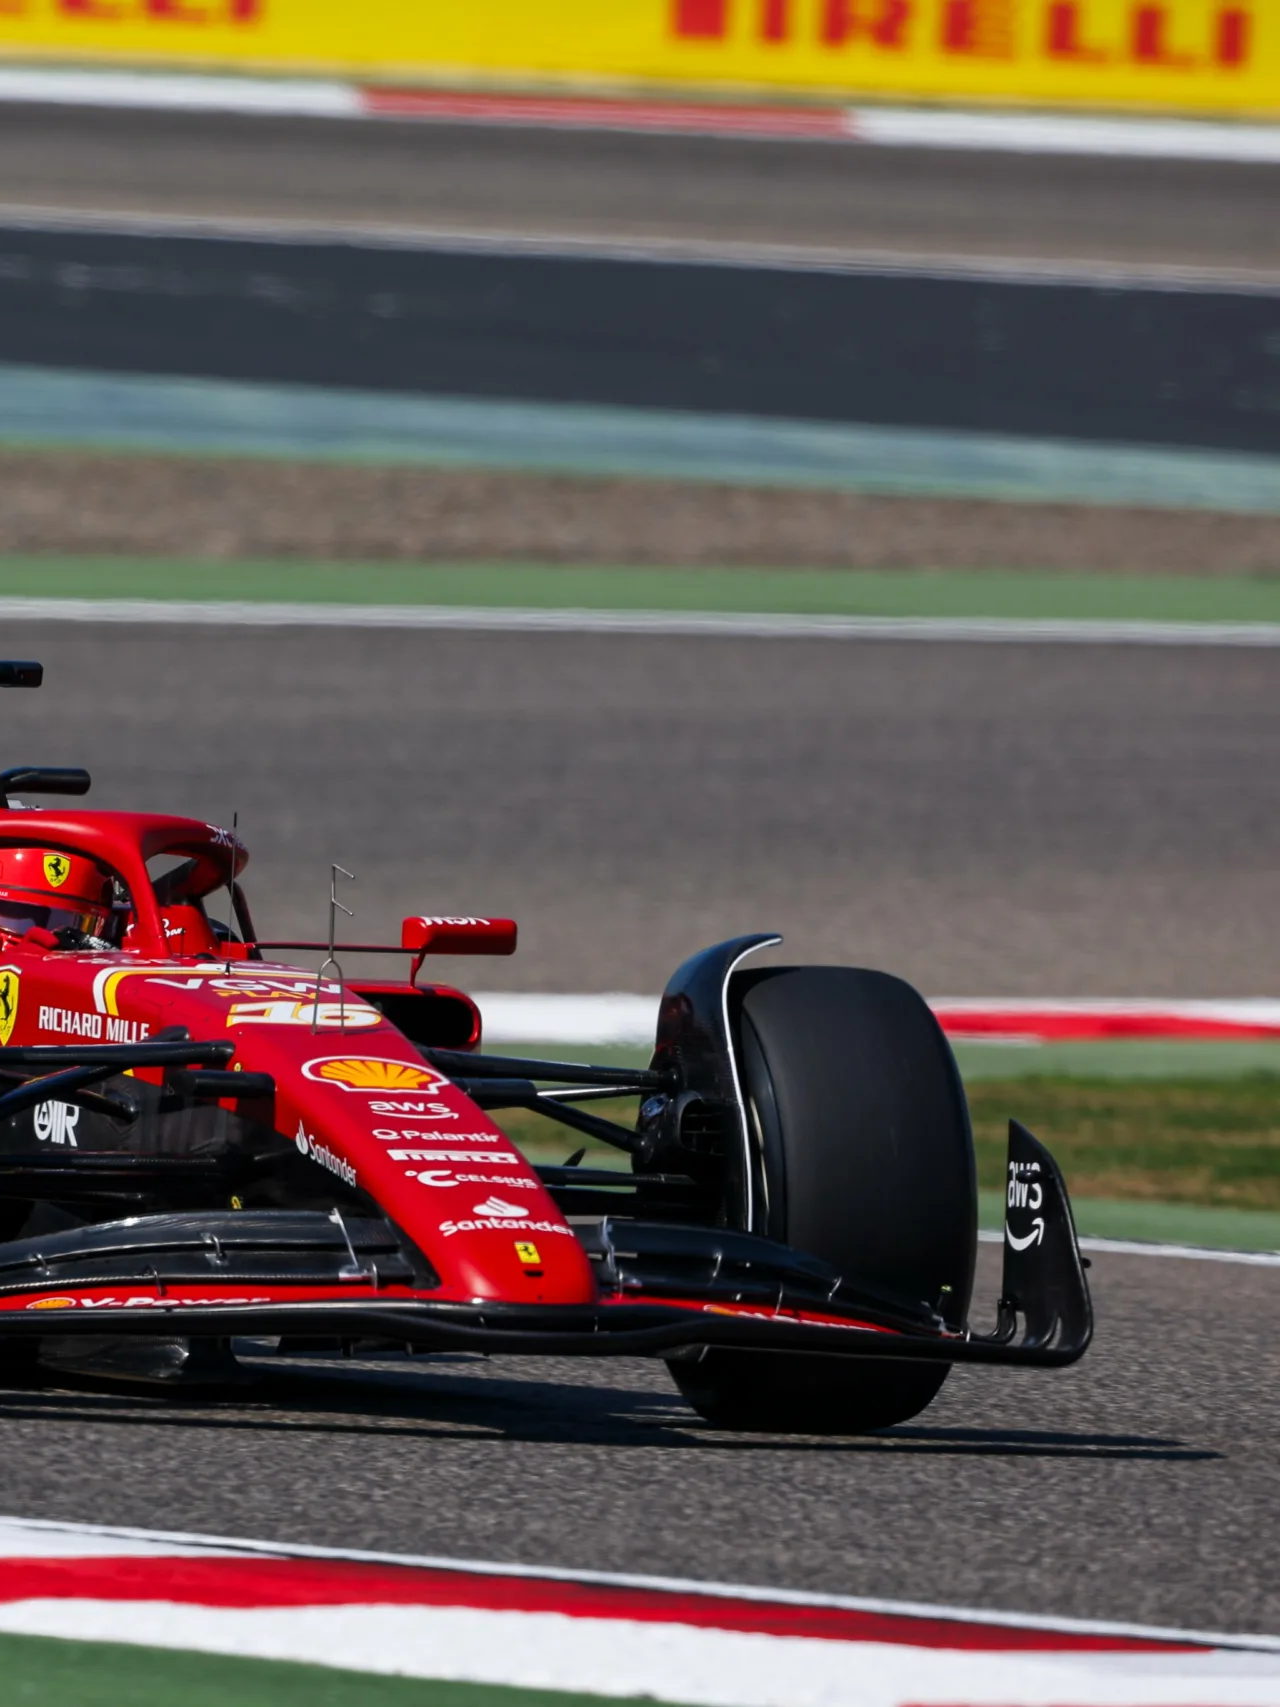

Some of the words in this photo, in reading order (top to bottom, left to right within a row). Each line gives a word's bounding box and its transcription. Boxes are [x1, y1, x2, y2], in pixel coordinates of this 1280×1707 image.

[226, 1001, 383, 1028] 16
[39, 1006, 102, 1039] RICHARD
[106, 1017, 151, 1044] MILLE
[368, 1101, 451, 1114] aws
[401, 1130, 500, 1143] Palantir
[309, 1134, 357, 1188] Santander
[387, 1149, 519, 1164] PIRELLI
[455, 1173, 538, 1187] CELSIUS
[438, 1216, 575, 1238] Santander
[80, 1297, 271, 1308] V-Power
